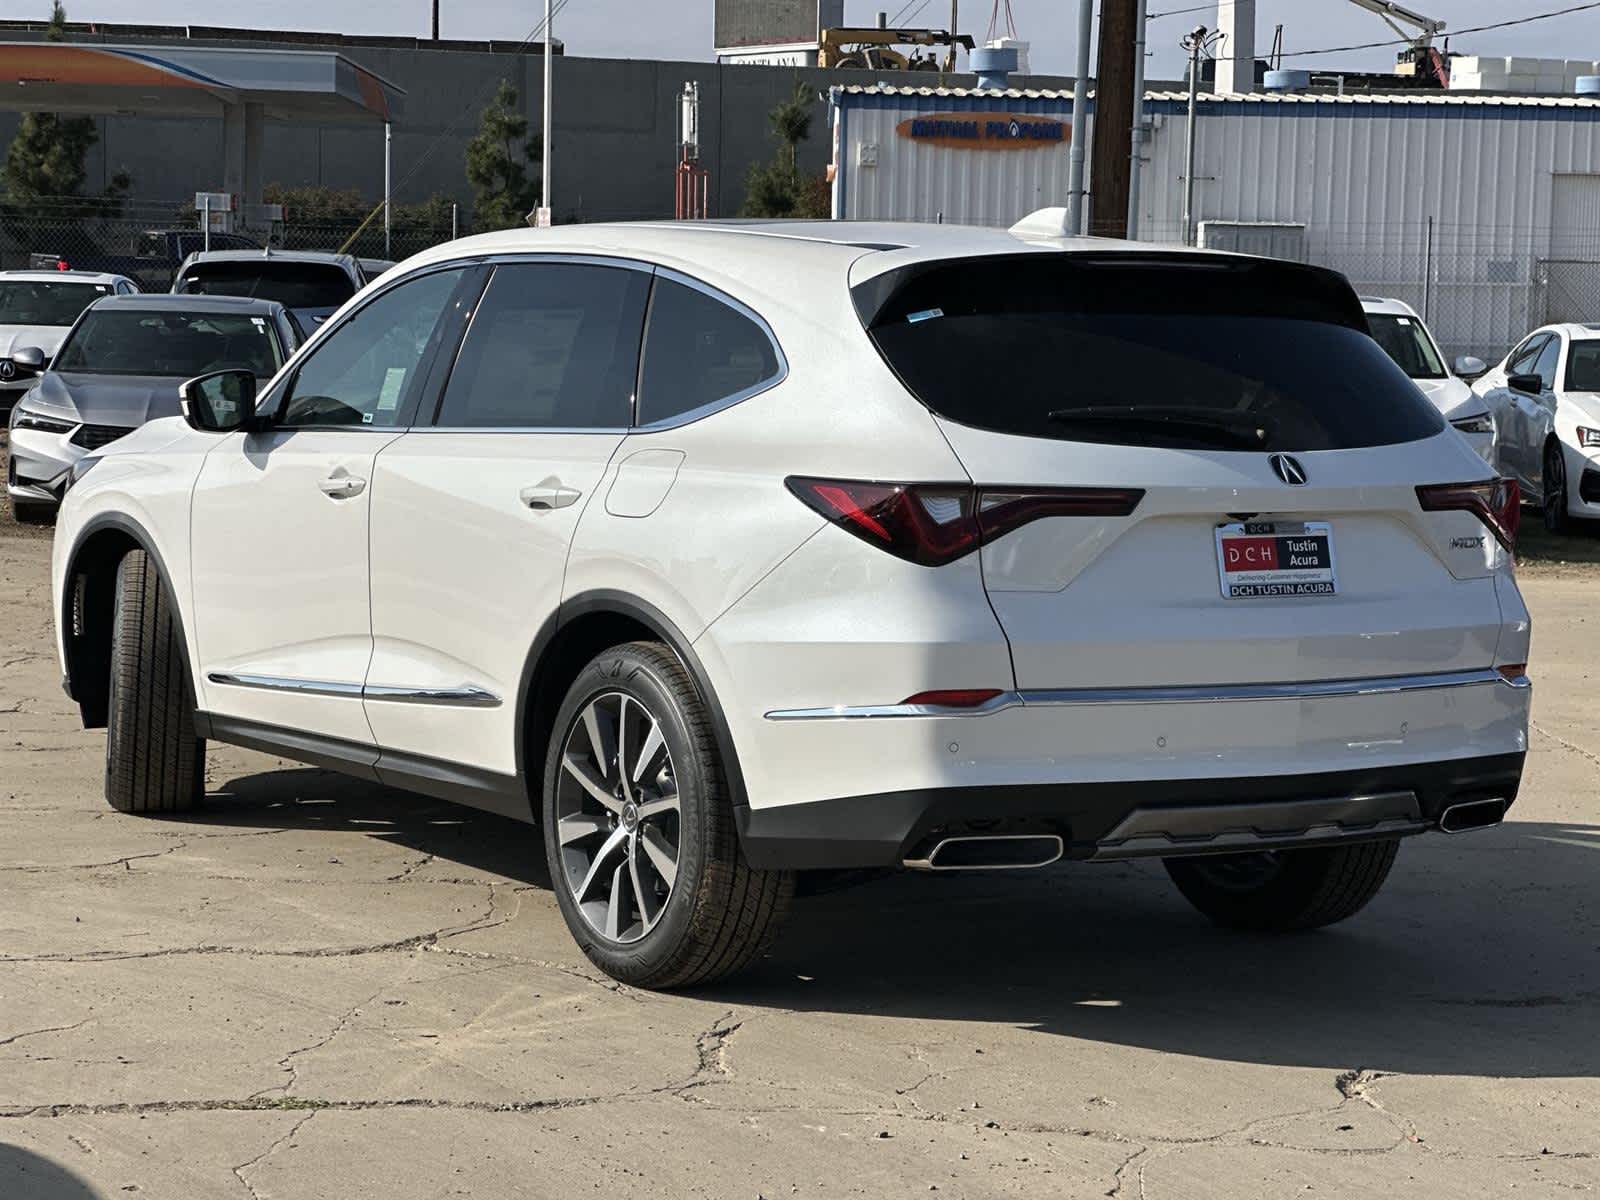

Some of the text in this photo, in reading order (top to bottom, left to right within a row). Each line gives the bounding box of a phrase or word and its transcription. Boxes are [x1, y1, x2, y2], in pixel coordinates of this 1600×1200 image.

[1250, 525, 1271, 533] DCH
[1287, 540, 1318, 552] Tustin
[1449, 535, 1485, 550] MDX
[1229, 547, 1272, 562] DCH
[1290, 554, 1319, 566] Acura
[1231, 583, 1333, 596] DCH TUSTIN ACURA
